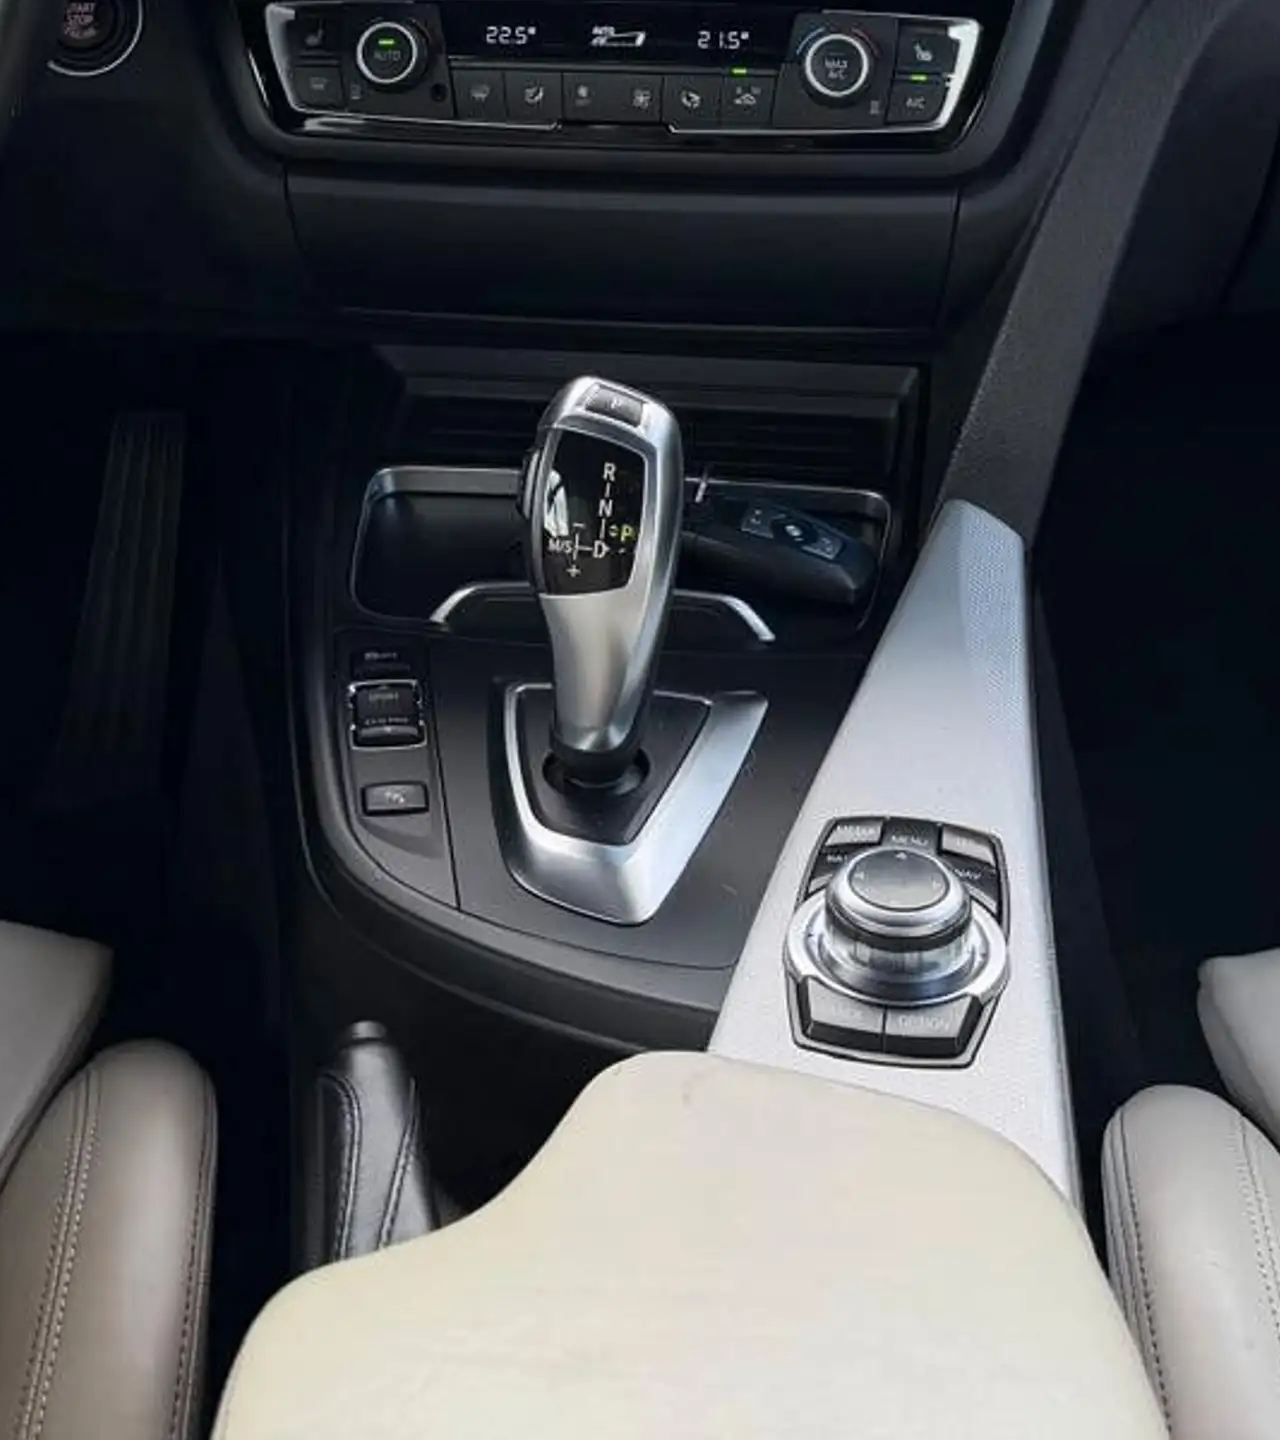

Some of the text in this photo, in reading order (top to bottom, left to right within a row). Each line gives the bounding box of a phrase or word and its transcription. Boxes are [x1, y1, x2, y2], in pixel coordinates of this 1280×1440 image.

[373, 49, 402, 62] AUTO
[603, 461, 618, 482] R
[597, 499, 614, 518] N
[592, 539, 608, 559] D
[890, 834, 929, 847] MENU
